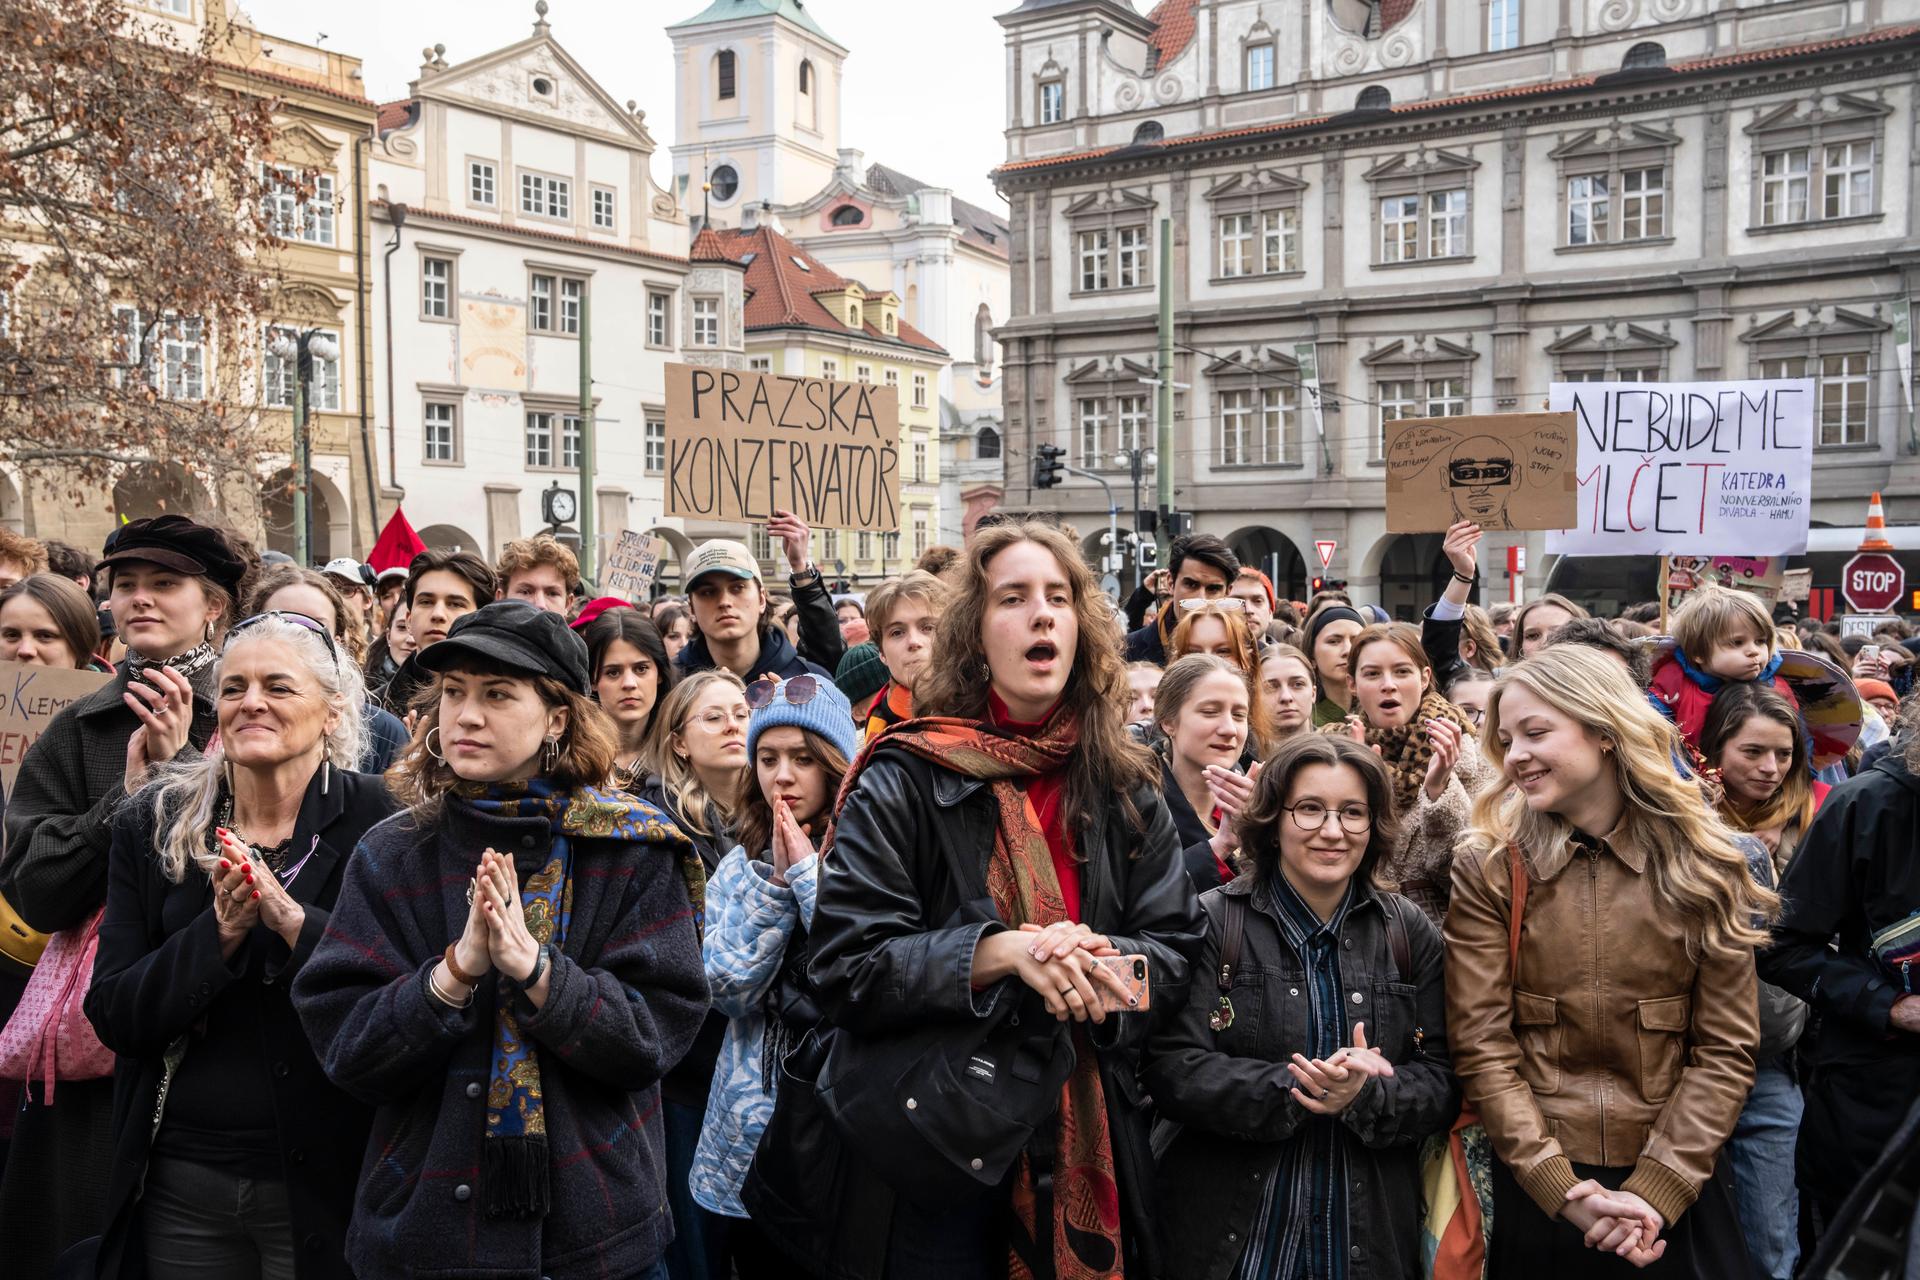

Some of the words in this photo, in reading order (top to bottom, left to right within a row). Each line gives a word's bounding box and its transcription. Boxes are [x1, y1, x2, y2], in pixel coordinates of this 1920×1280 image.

[692, 370, 880, 438] PRAŽSKÁ
[1573, 389, 1803, 453] NEBUDEME
[671, 437, 898, 528] KONZERVATOŘ
[1721, 471, 1786, 491] KATEDRA
[1719, 507, 1757, 518] DIVADLA
[1769, 509, 1794, 520] HAMU
[1853, 570, 1896, 593] STOP
[10, 672, 73, 720] KLEM
